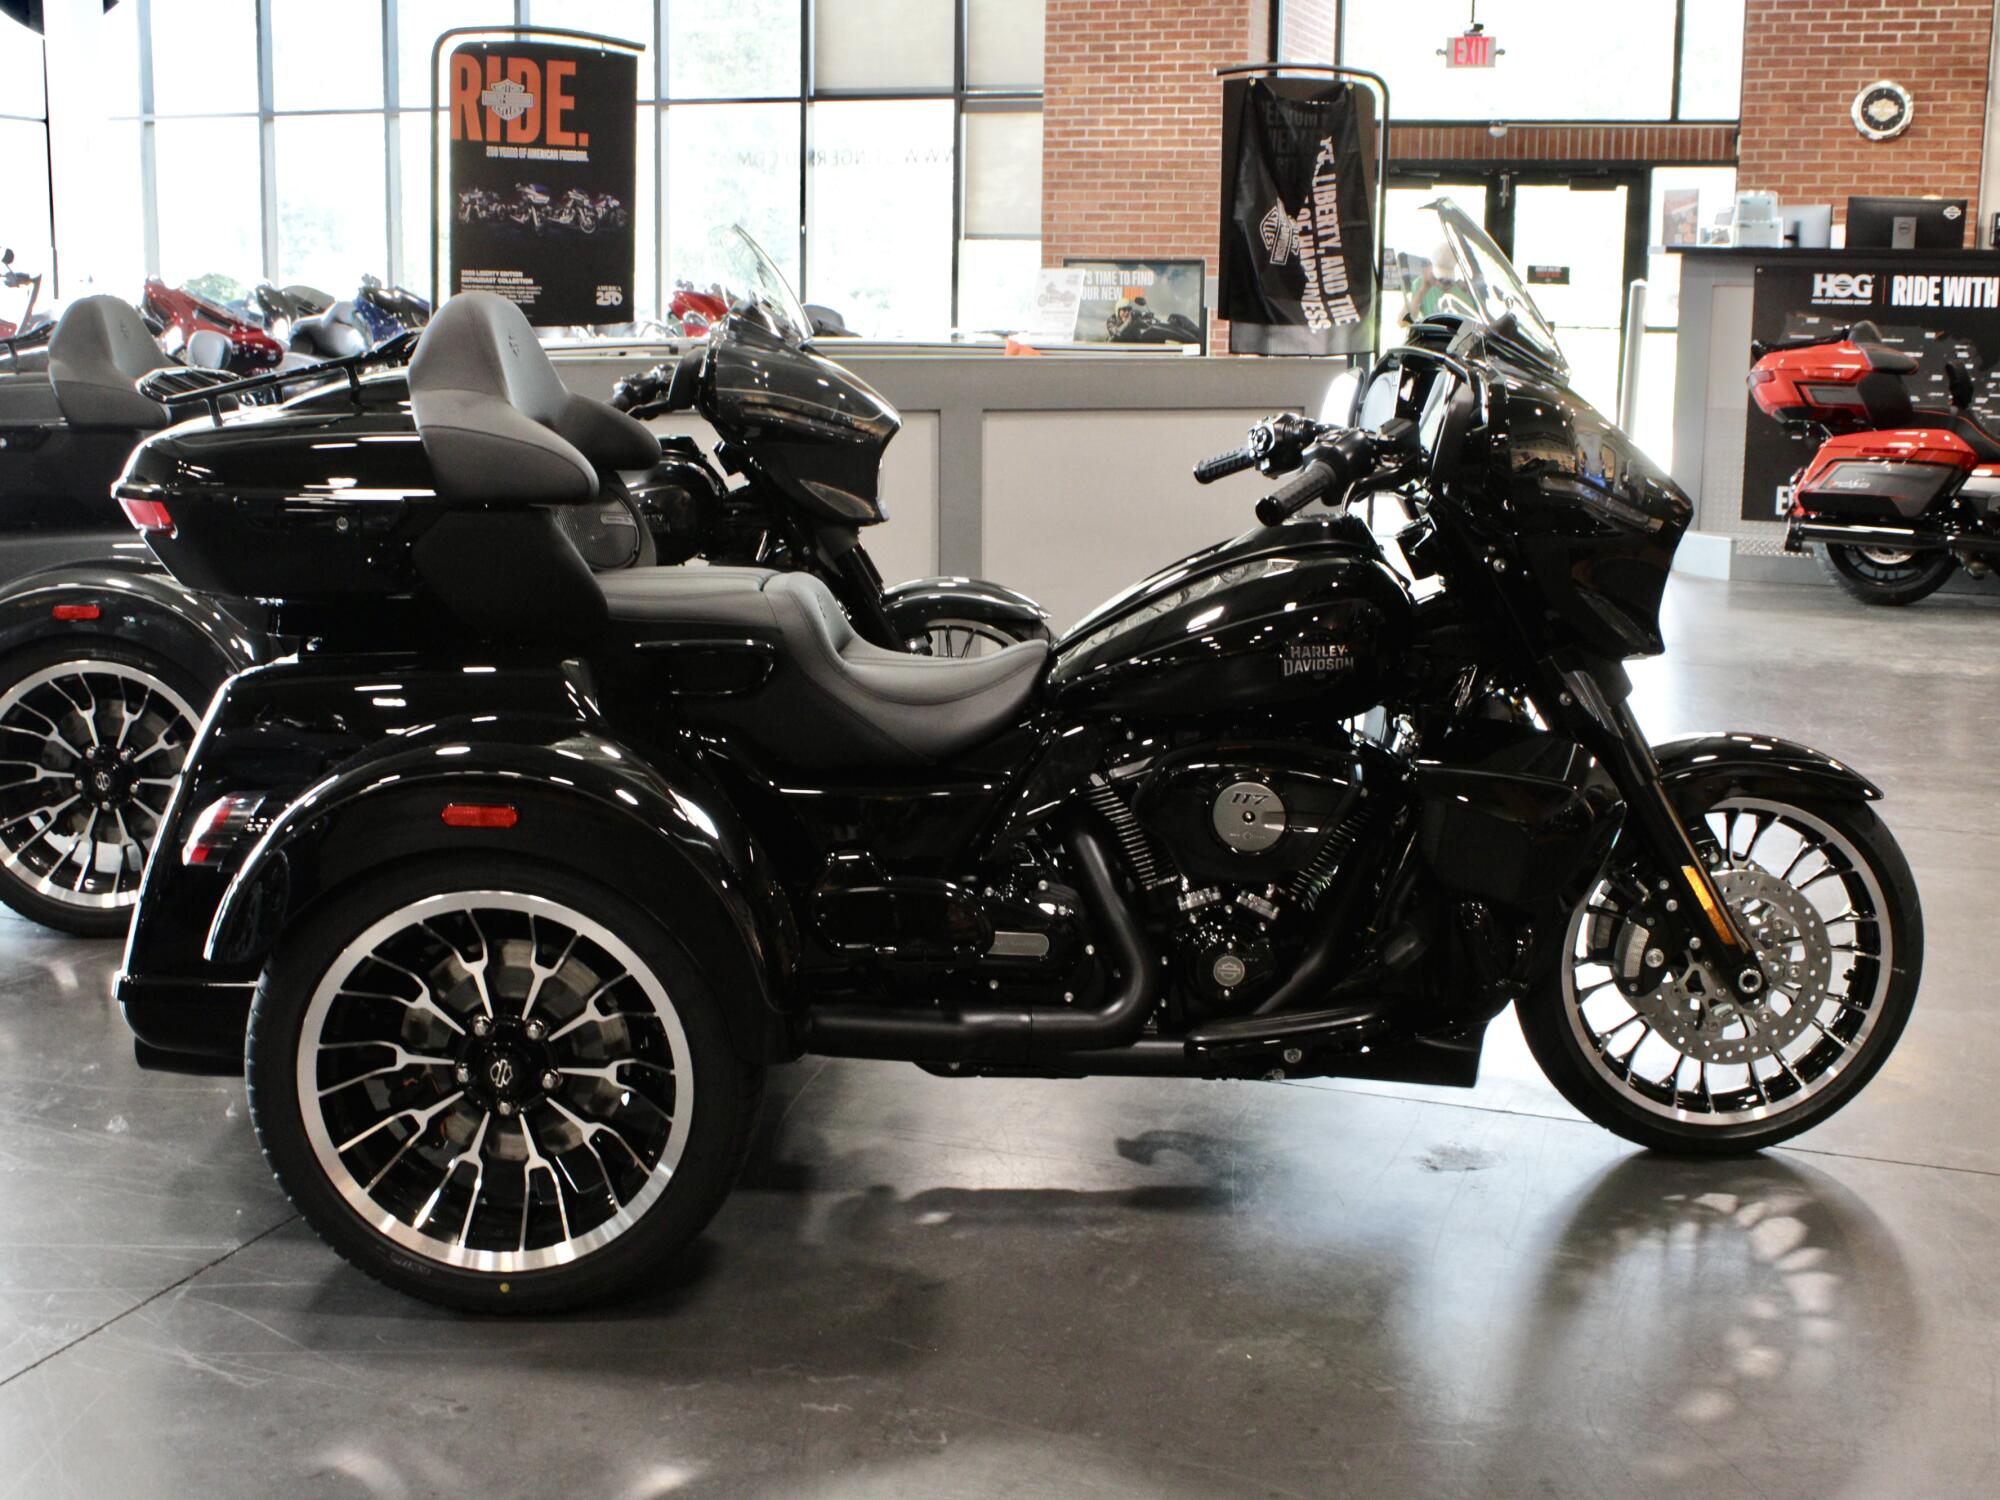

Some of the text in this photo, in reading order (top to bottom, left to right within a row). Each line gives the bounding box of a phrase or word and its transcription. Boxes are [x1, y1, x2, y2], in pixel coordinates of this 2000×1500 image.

[1454, 37, 1489, 65] EXIT
[451, 53, 590, 147] RIDE.
[519, 148, 527, 159] OF
[1312, 172, 1343, 255] LIBERTY,
[1094, 270, 1118, 286] TIME
[1119, 270, 1131, 286] TO
[1131, 270, 1154, 287] FIND
[1320, 255, 1349, 295] AND
[1812, 273, 1874, 298] HOG
[596, 291, 623, 306] 250
[1081, 286, 1099, 300] OUR
[1101, 286, 1123, 300] NEW
[1891, 275, 2000, 308] RIDE WITH
[1327, 294, 1361, 327] THE
[1283, 657, 1355, 677] DAVIDSON
[1232, 792, 1270, 806] 117
